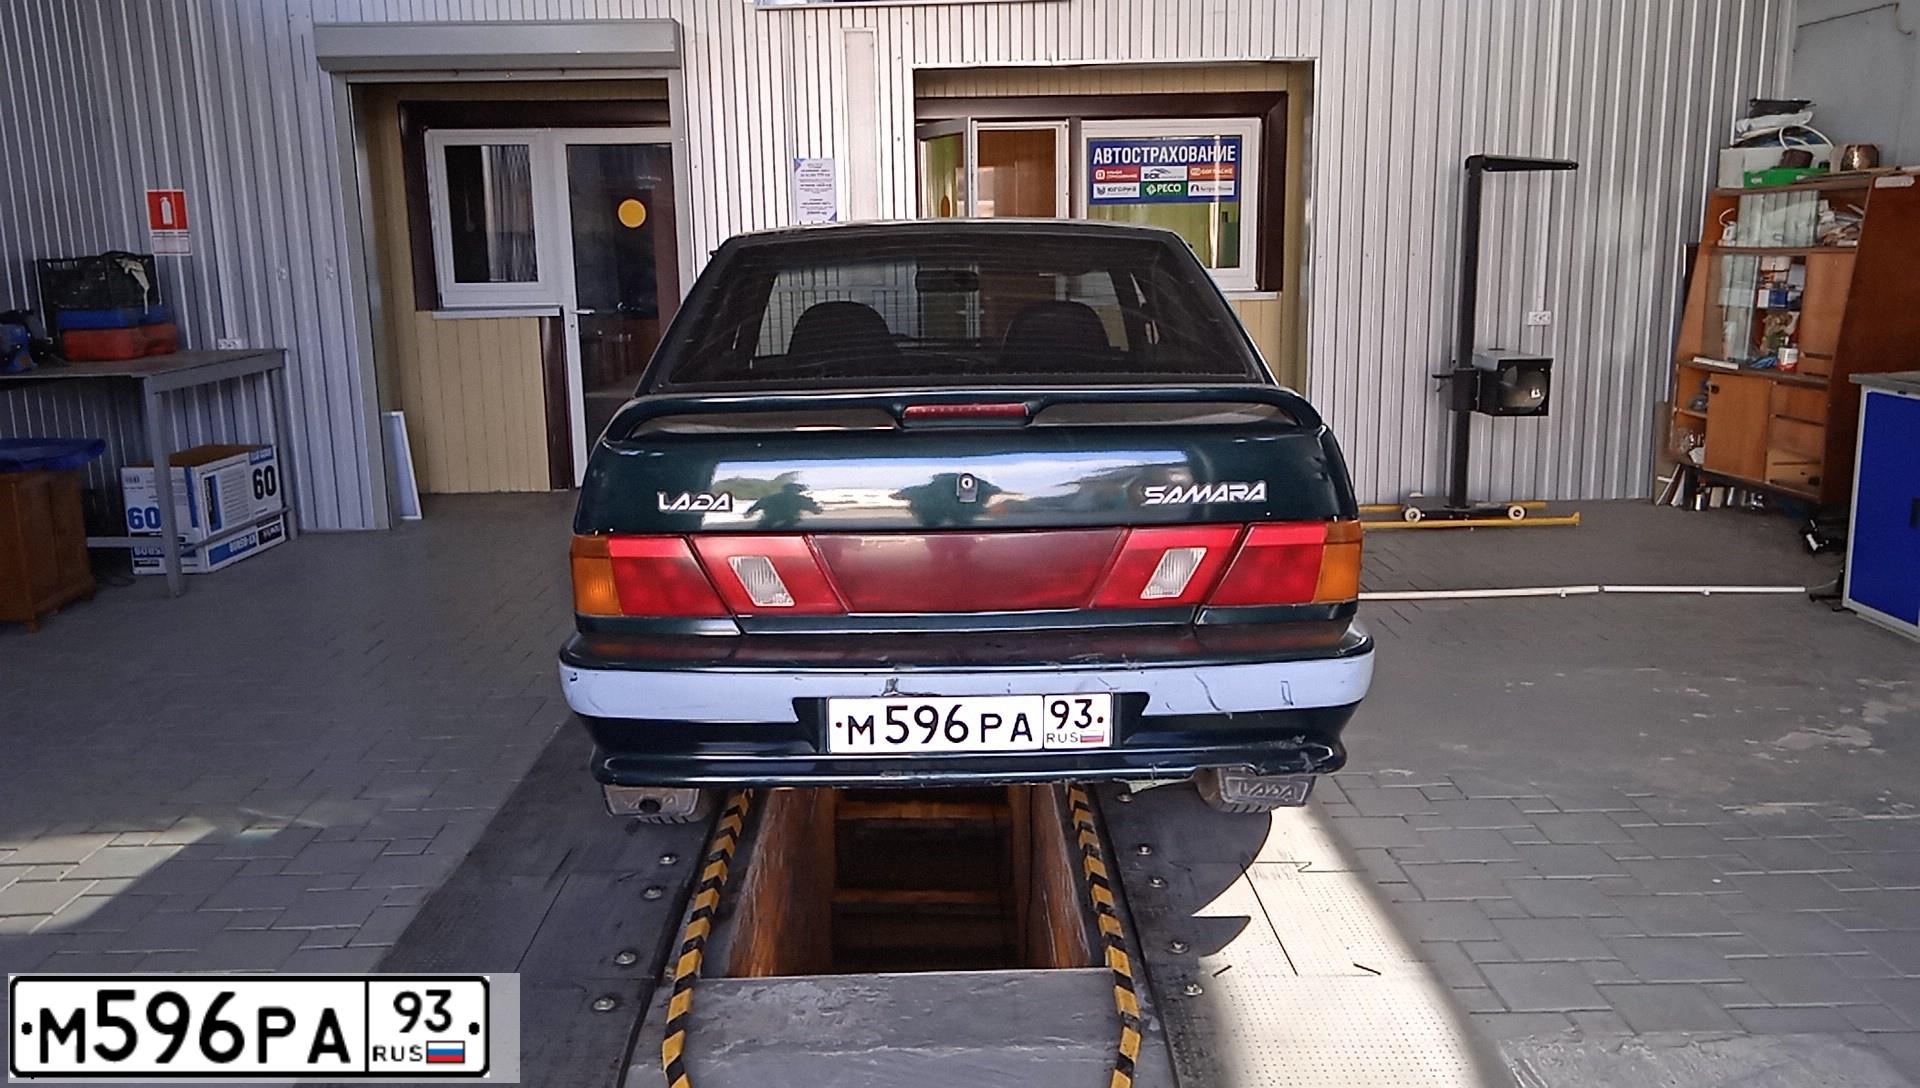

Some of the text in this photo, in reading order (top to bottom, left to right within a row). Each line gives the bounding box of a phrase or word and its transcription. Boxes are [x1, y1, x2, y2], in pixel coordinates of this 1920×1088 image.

[1093, 145, 1236, 165] АВТОСТРАХОВАНИЕ
[1156, 183, 1182, 193] РЕСО
[252, 465, 277, 500] 60
[657, 491, 731, 511] LADA
[1144, 482, 1267, 505] SAMARA
[127, 506, 161, 530] 60
[1050, 699, 1093, 729] 93
[1046, 732, 1079, 743] RUS
